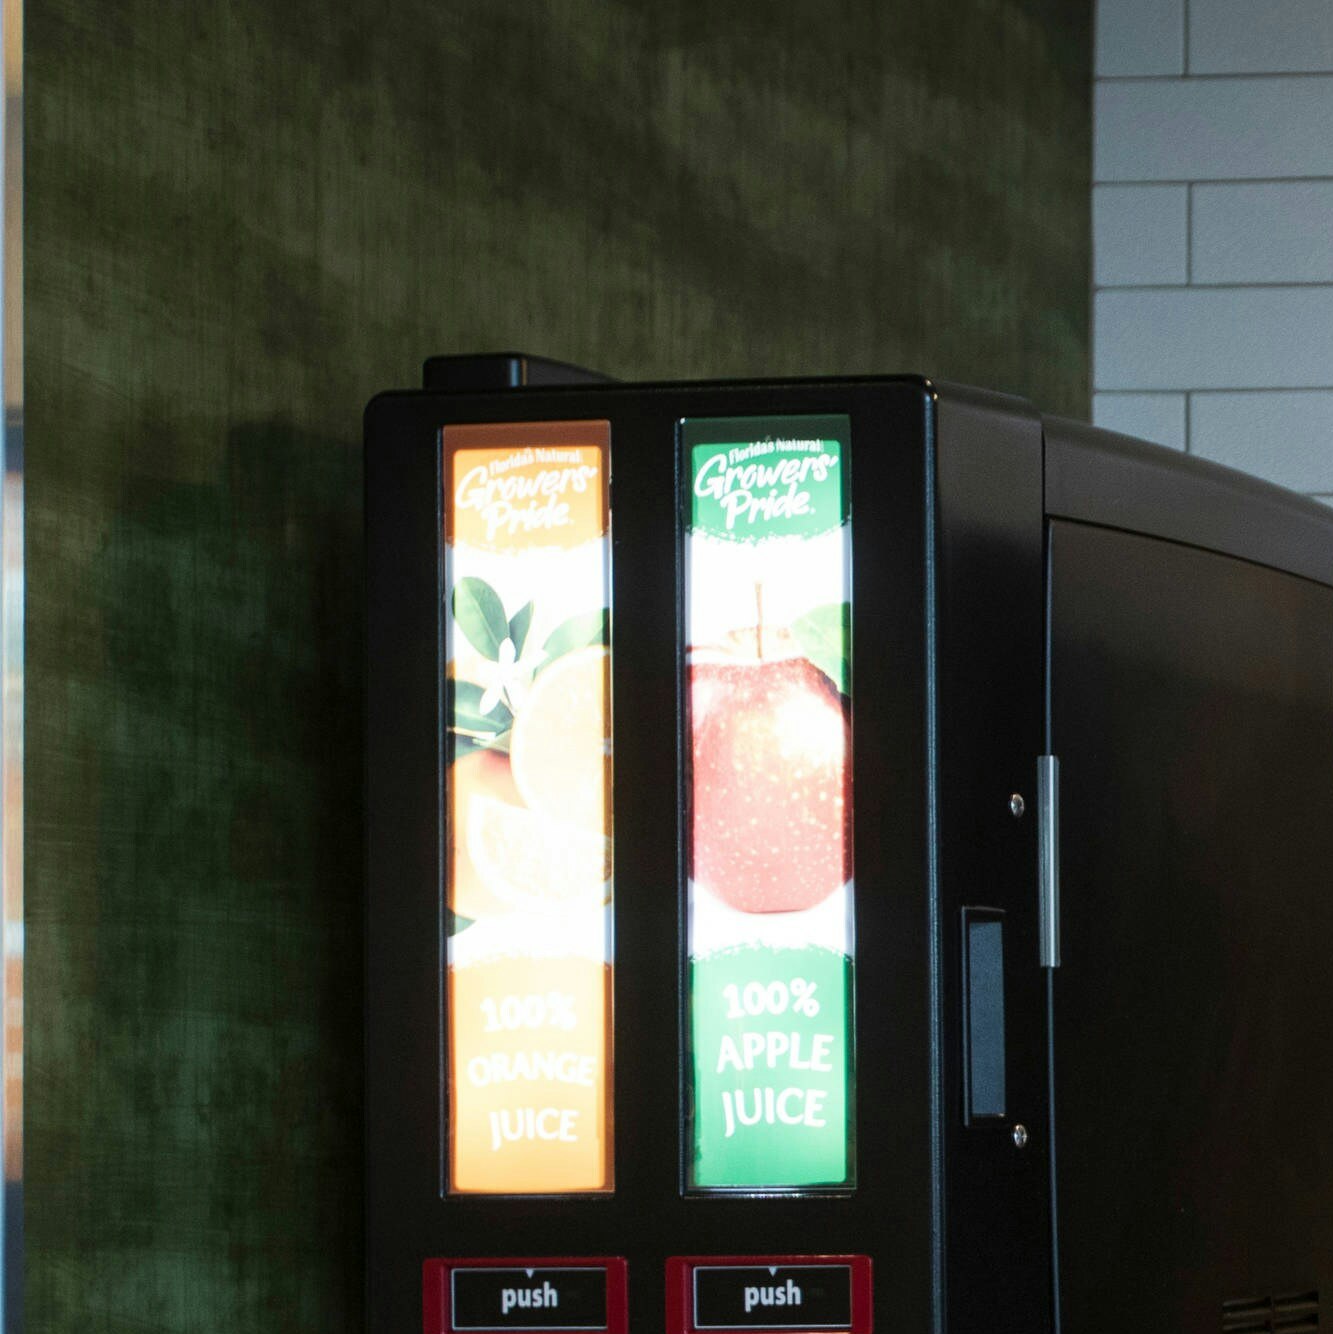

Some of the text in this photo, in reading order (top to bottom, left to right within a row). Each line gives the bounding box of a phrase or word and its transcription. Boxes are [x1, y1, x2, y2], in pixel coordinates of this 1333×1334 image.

[777, 439, 821, 452] Natural
[480, 991, 577, 1032] 100%
[723, 978, 819, 1019] 100%
[467, 1052, 597, 1087] ORANGE
[716, 1033, 834, 1073] APPLE
[489, 1108, 579, 1151] JUICE
[721, 1088, 827, 1137] JUICE
[502, 1282, 557, 1314] push
[744, 1280, 800, 1313] push
